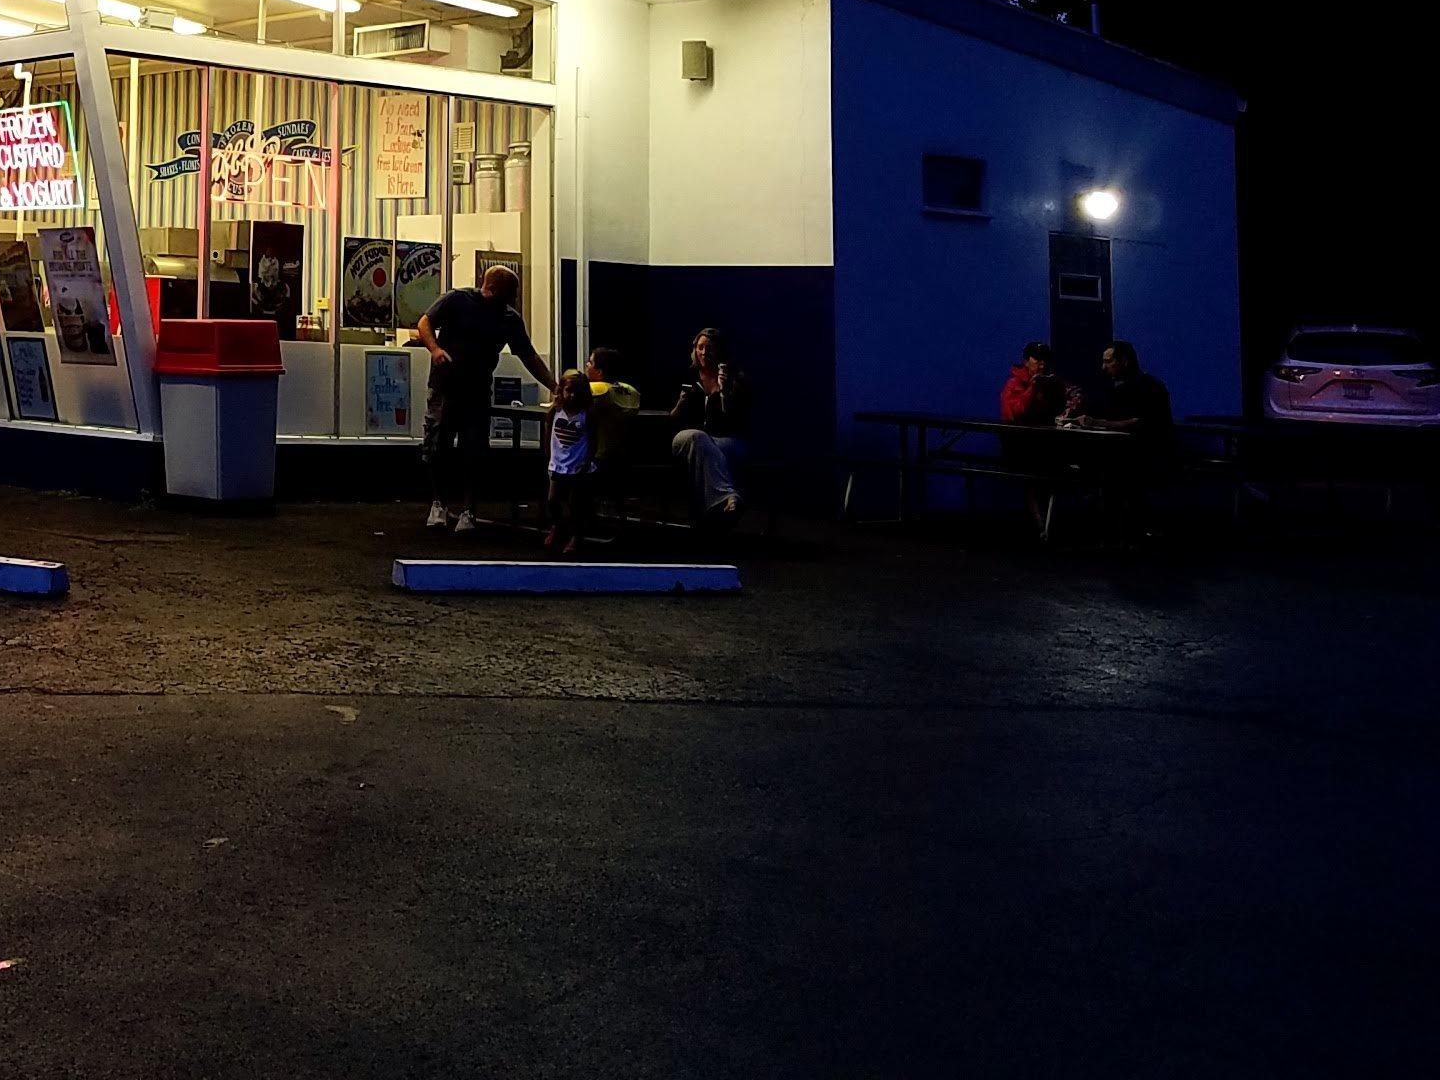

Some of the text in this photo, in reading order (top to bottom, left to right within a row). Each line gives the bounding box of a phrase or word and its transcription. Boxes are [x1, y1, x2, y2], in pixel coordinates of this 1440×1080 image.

[277, 123, 310, 138] SUNDAES
[11, 179, 74, 206] YOGURT
[400, 250, 439, 284] CAKES
